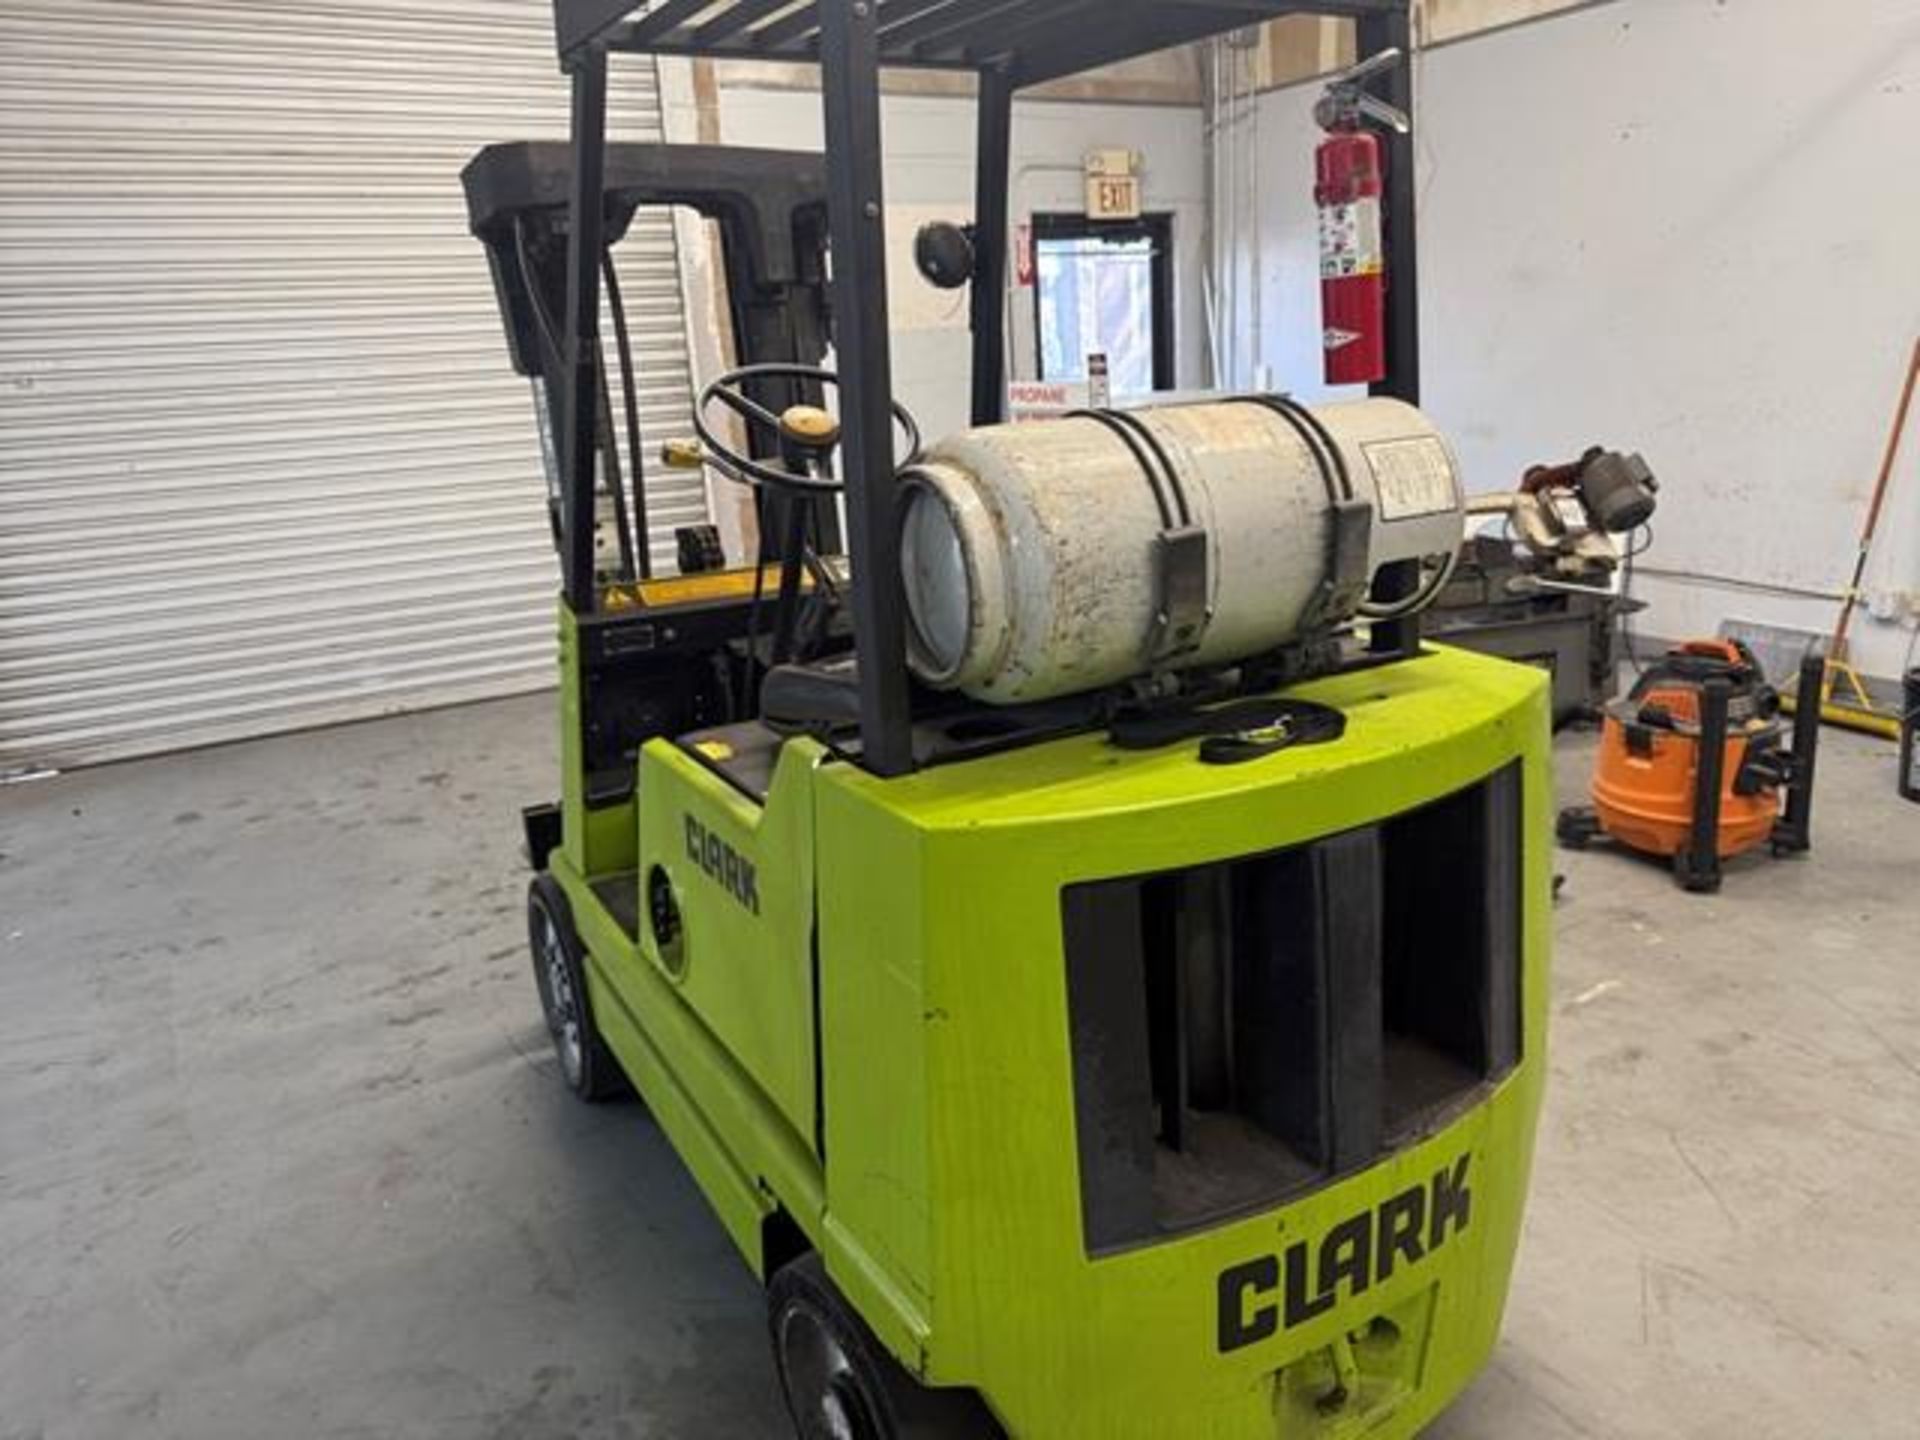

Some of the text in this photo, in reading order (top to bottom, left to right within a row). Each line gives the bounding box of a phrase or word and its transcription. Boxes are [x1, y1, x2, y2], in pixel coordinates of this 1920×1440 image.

[1100, 182, 1132, 213] EXIT
[1010, 386, 1066, 404] PROPANE
[684, 812, 760, 916] CLARK
[1218, 1151, 1471, 1354] CLARK
